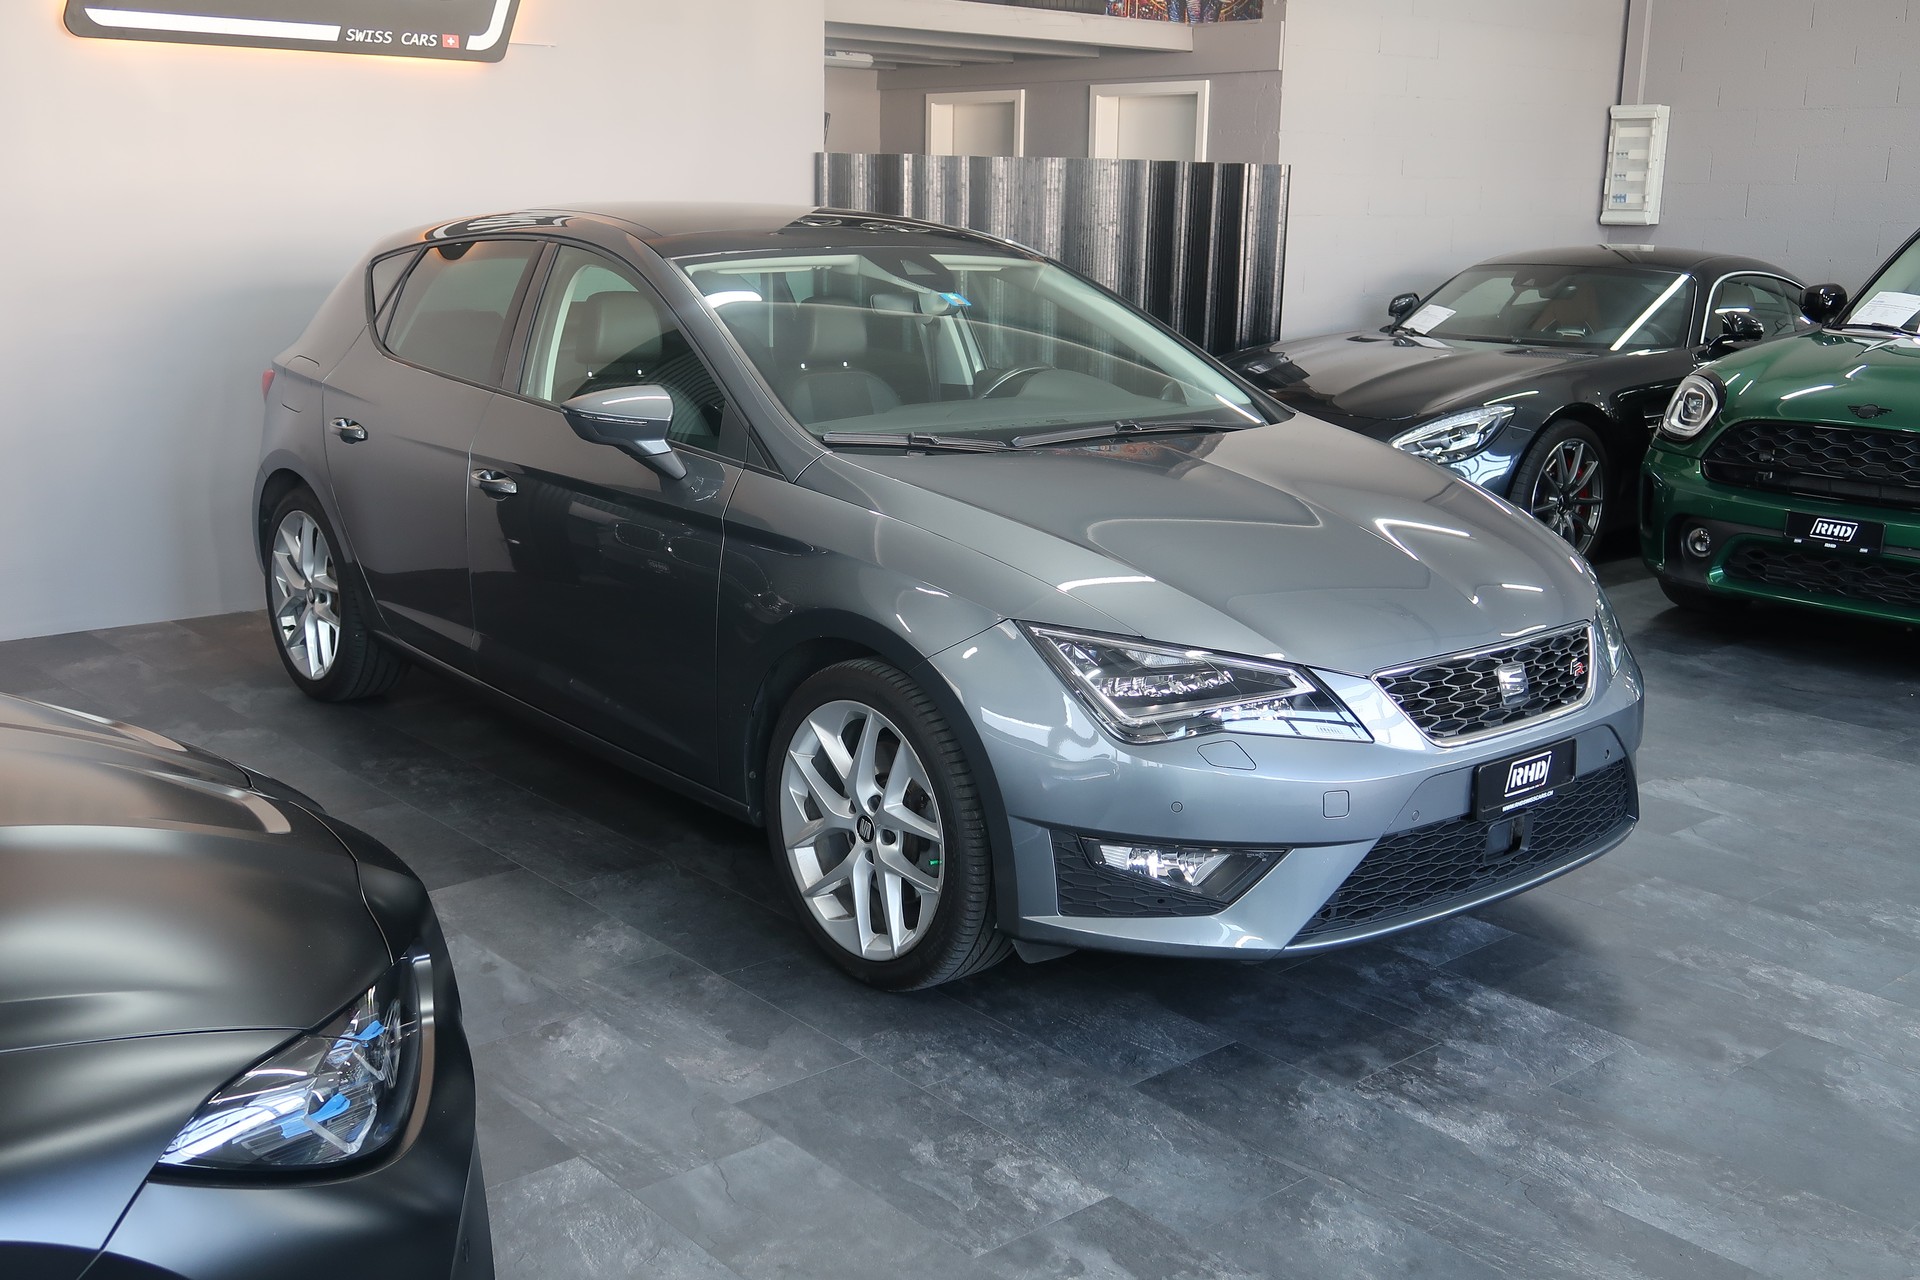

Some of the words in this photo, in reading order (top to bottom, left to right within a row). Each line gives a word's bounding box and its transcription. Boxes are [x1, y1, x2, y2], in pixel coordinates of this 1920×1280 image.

[345, 28, 393, 44] SWISS
[401, 32, 438, 47] CARS
[1815, 522, 1852, 537] RHD
[1510, 760, 1546, 788] RHD
